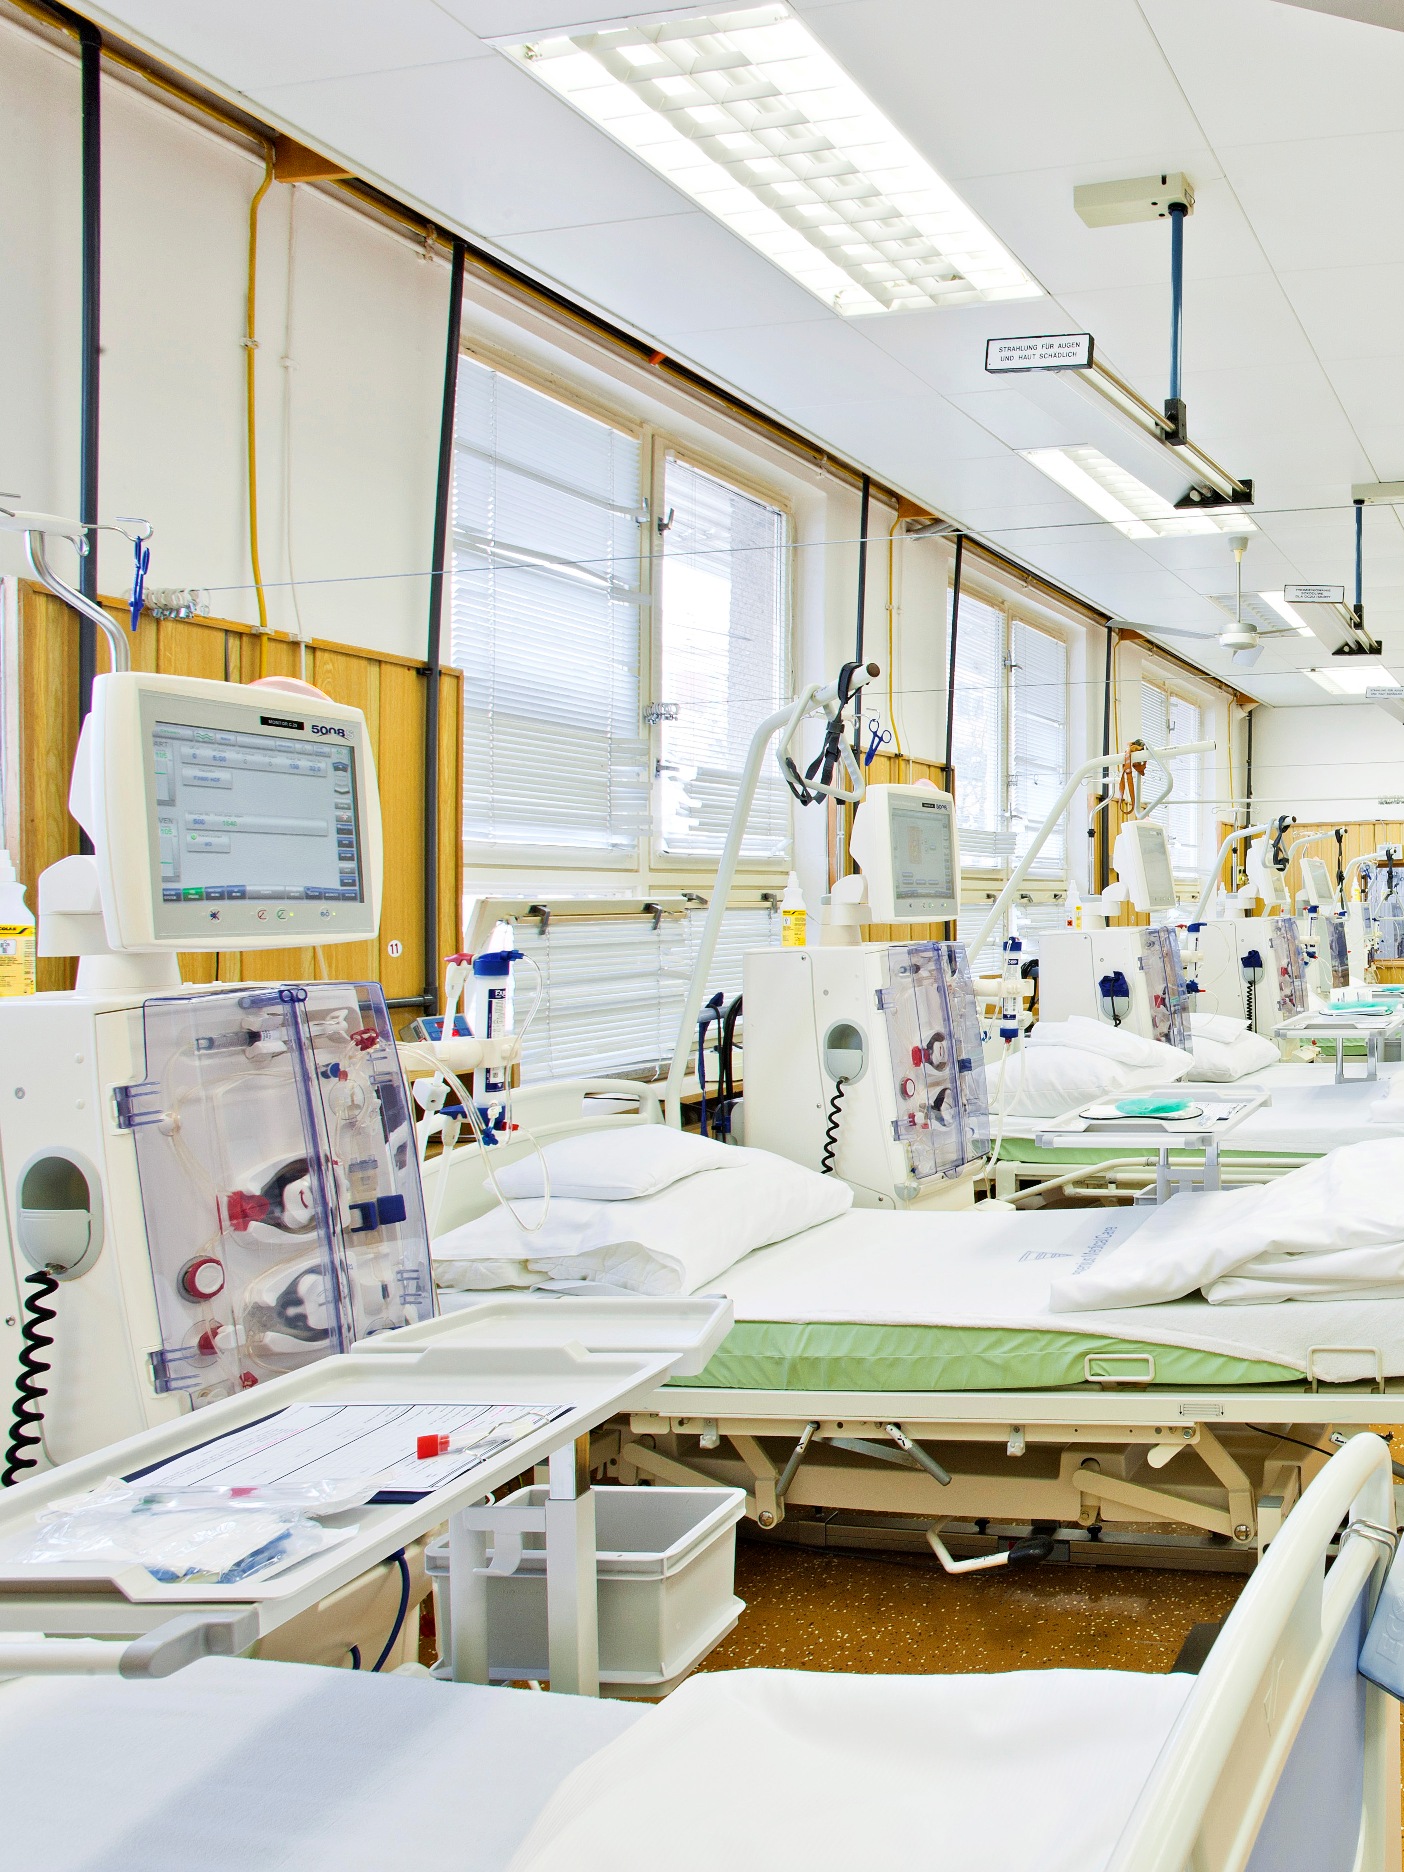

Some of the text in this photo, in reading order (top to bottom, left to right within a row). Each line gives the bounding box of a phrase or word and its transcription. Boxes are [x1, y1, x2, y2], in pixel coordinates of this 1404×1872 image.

[998, 341, 1081, 353] STRAHLUNG FÜR AUGEN
[1038, 351, 1077, 359] SCHÄDLICH
[390, 943, 399, 955] 11
